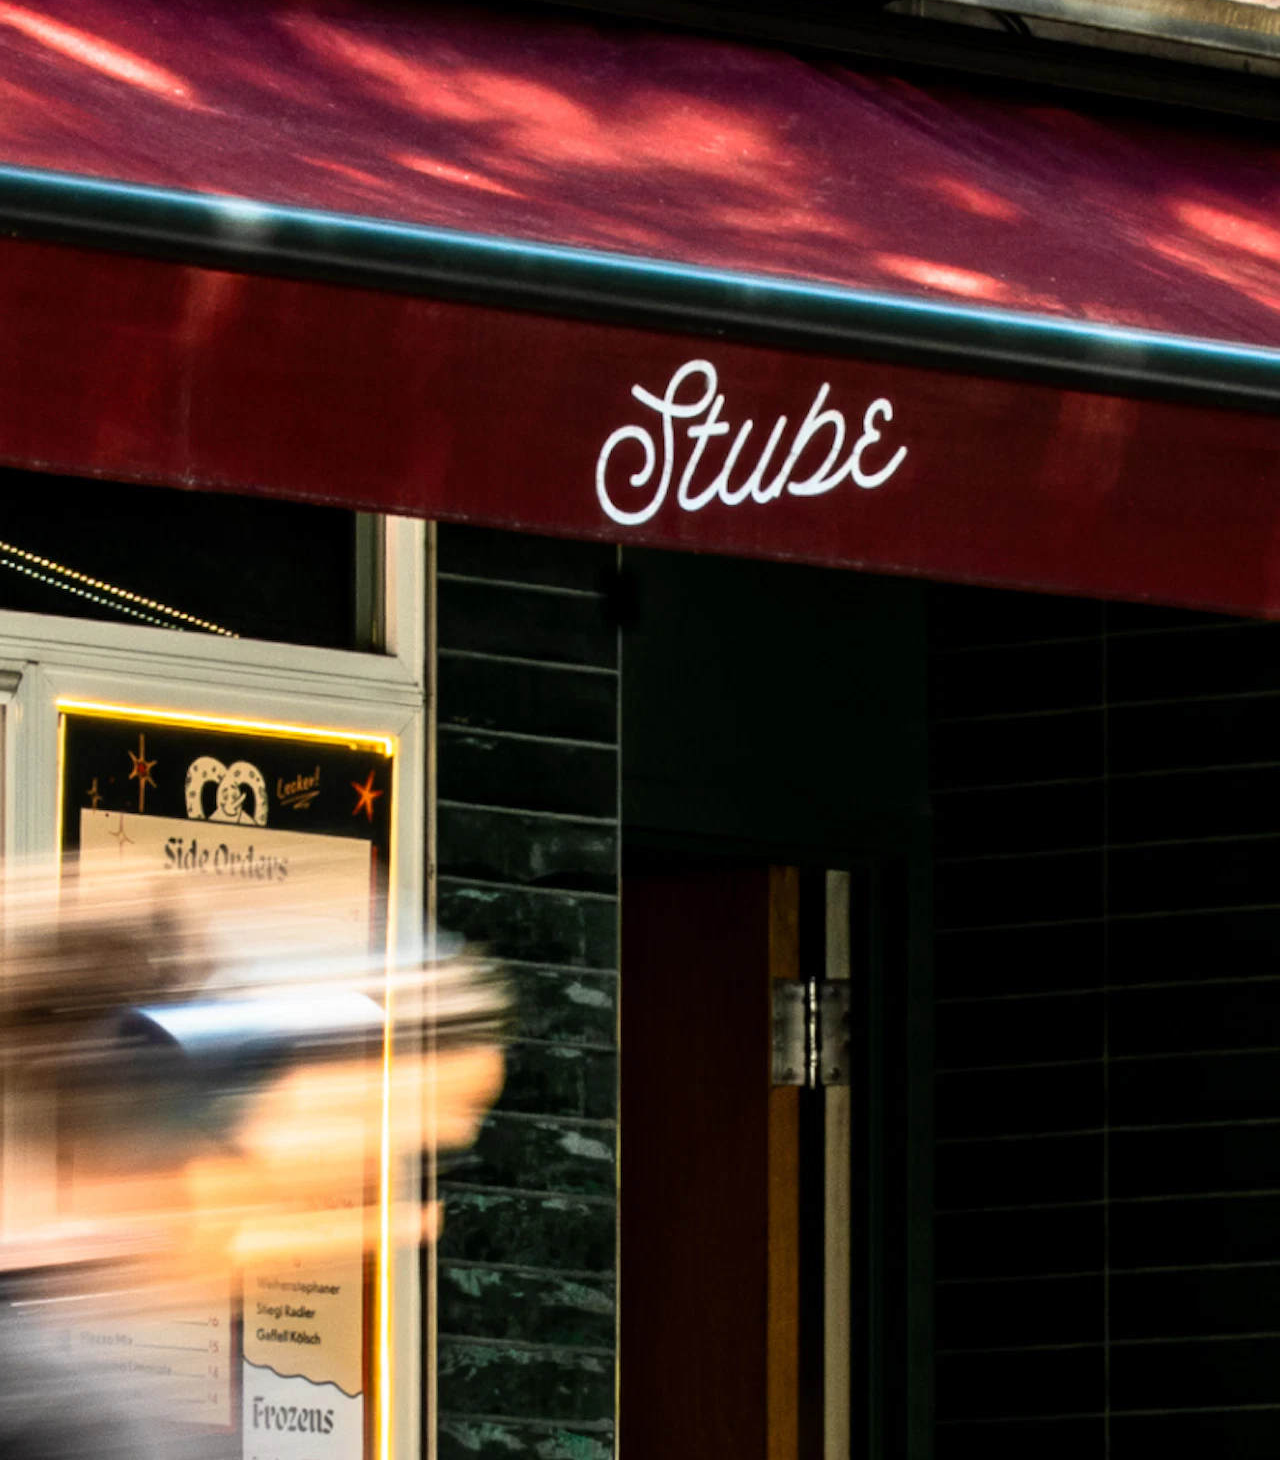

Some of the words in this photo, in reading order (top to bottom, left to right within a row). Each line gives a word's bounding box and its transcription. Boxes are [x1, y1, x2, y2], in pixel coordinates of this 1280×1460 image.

[595, 358, 908, 526] Stube
[276, 766, 320, 799] Lecker!
[164, 837, 209, 873] Side
[213, 843, 289, 882] Orders
[284, 1304, 316, 1319] Radler
[253, 1396, 334, 1435] Frozens
